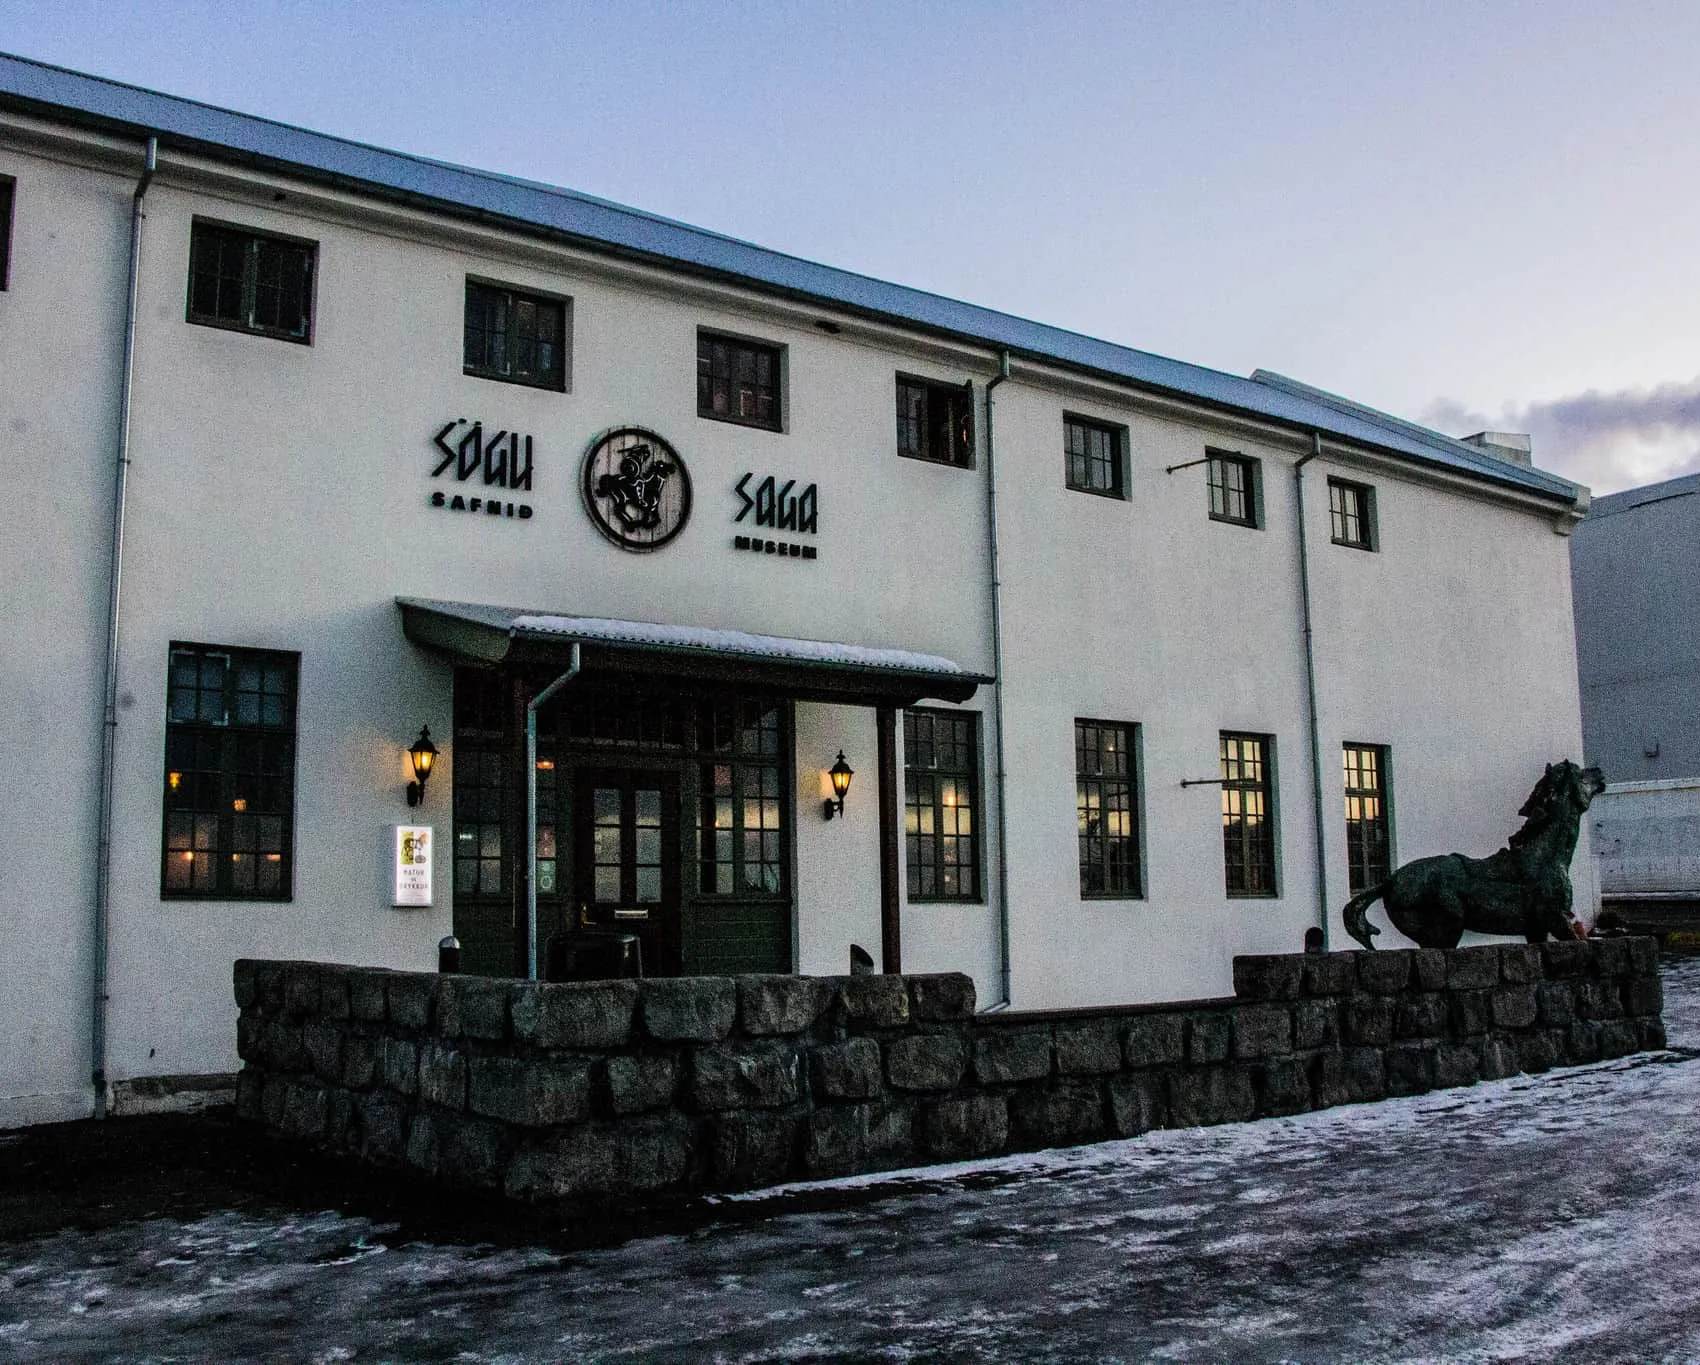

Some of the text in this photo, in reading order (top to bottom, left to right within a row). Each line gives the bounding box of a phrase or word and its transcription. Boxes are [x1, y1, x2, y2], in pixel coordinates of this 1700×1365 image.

[431, 418, 533, 491] SÖGU
[735, 472, 818, 534] SAGA
[734, 535, 817, 559] MUSEUM
